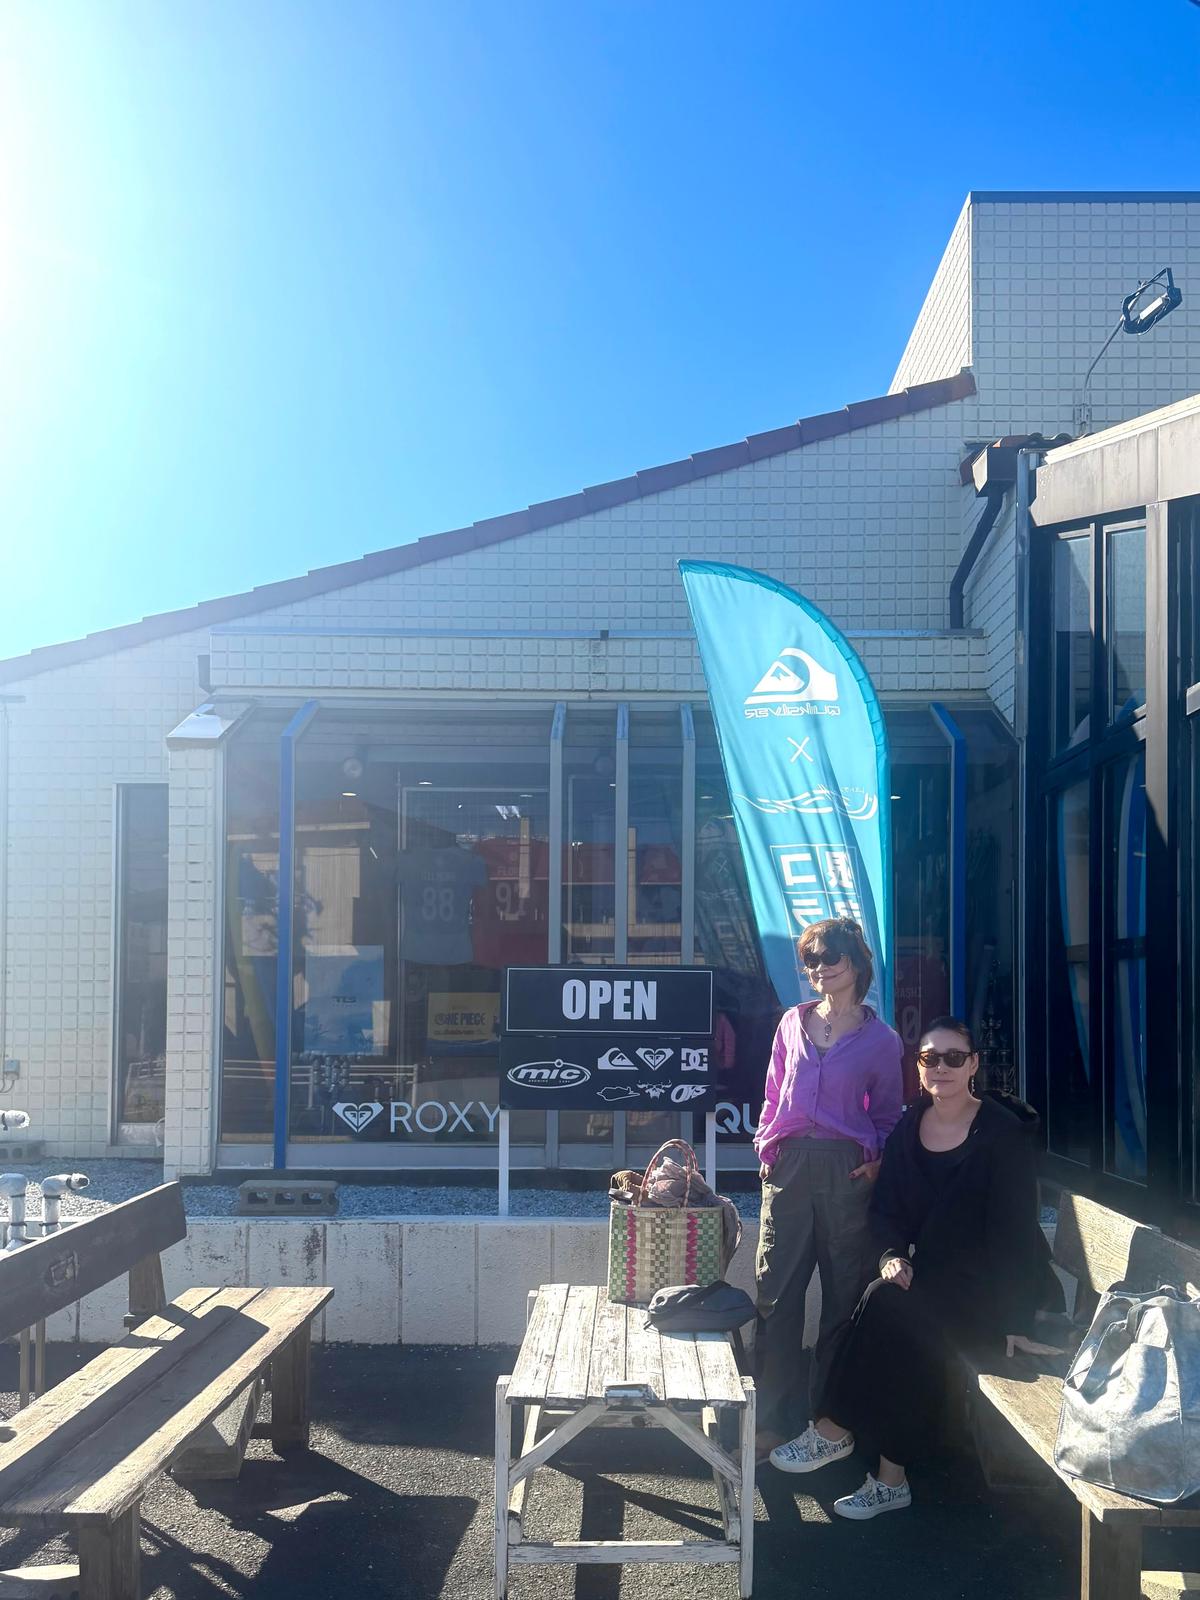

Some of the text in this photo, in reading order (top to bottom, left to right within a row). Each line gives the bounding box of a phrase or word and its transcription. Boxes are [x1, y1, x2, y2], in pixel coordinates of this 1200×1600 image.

[422, 887, 454, 921] 88
[562, 979, 657, 1021] OPEN
[517, 1059, 581, 1080] mic
[390, 1101, 501, 1133] ROXY
